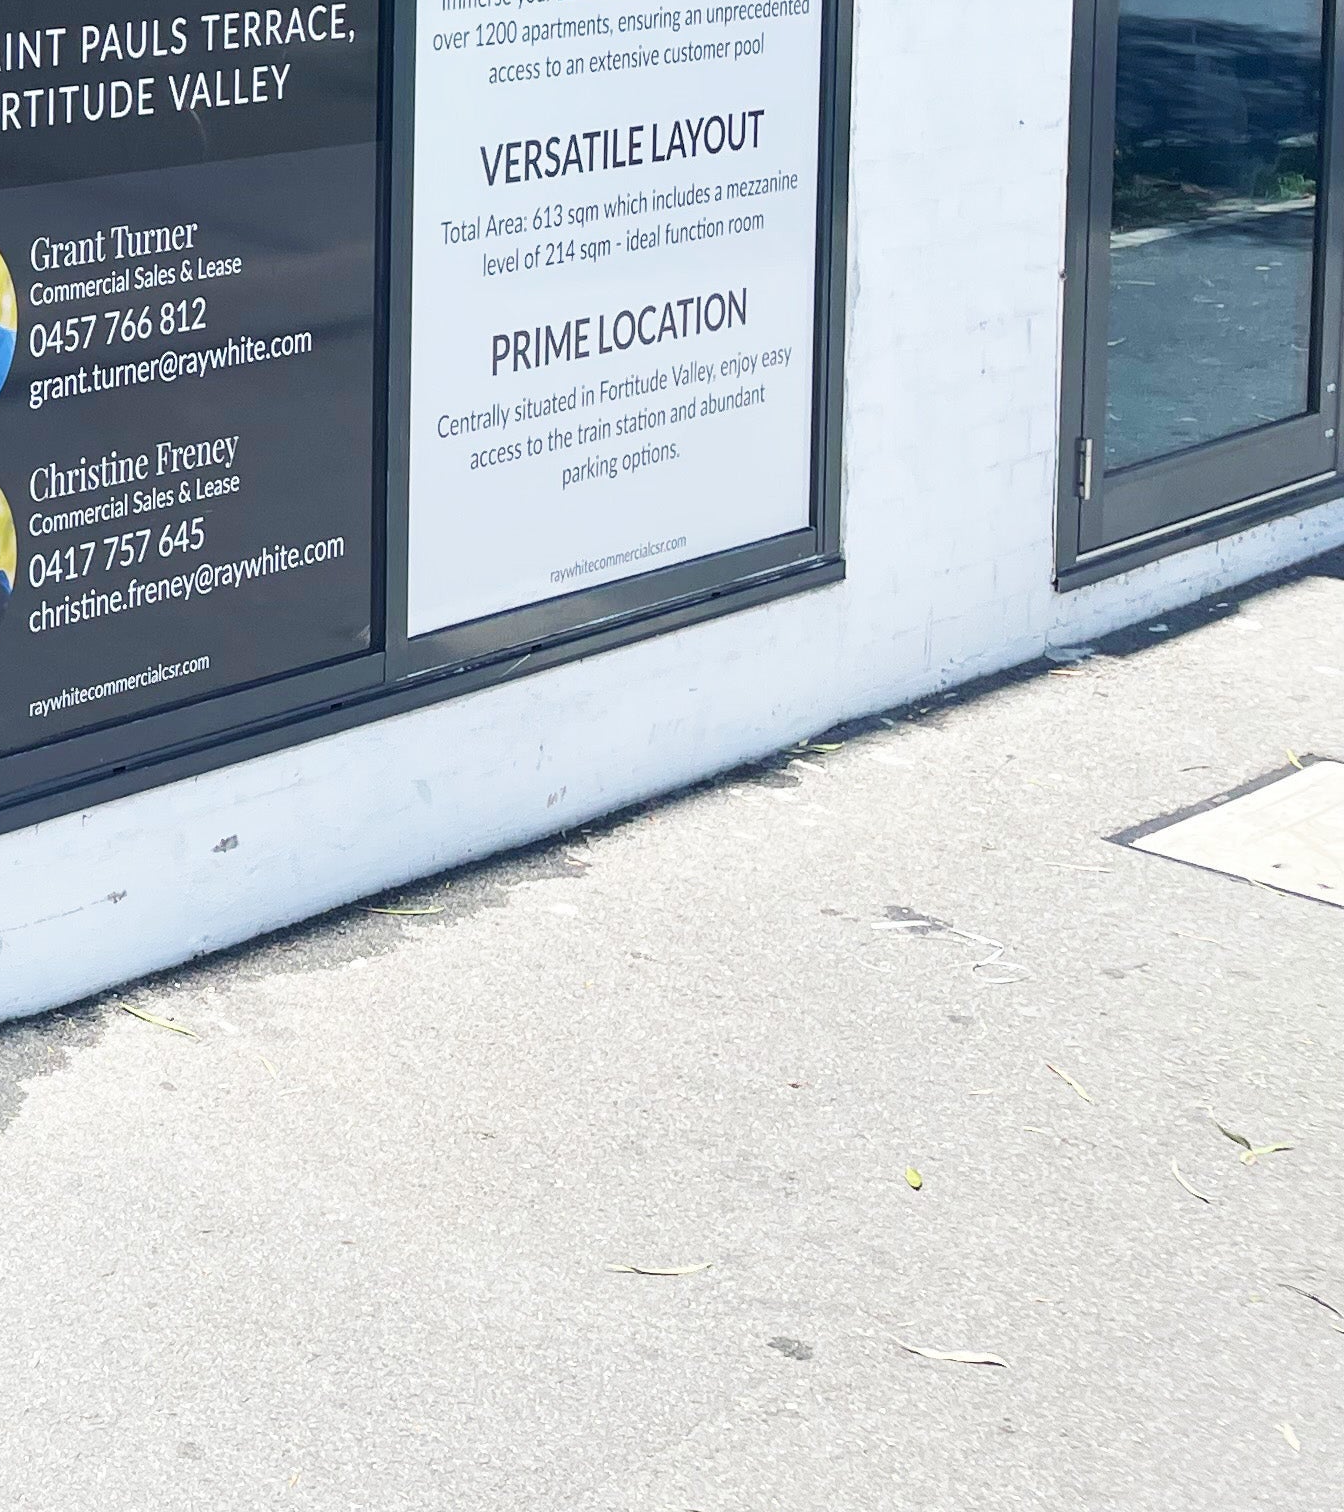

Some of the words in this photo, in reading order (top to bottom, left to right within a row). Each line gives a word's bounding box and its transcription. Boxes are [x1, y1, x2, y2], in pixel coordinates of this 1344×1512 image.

[82, 17, 187, 64] PAULS
[200, 3, 355, 51] TERRACE,
[432, 30, 471, 51] over
[475, 20, 518, 47] 1200
[521, 14, 614, 46] apartments,
[618, 6, 681, 33] ensuring
[684, 8, 702, 26] an
[488, 62, 541, 85] access
[545, 56, 562, 78] to
[566, 57, 584, 76] an
[589, 44, 660, 73] extensive
[663, 41, 731, 65] customer
[734, 31, 765, 62] pool
[168, 63, 291, 111] VALLEY
[479, 124, 644, 187] VERSATILE
[651, 109, 765, 163] LAYOUT
[440, 215, 481, 245] Total
[485, 214, 528, 238] Area:
[532, 203, 563, 231] 613
[567, 204, 599, 228] sqm
[603, 190, 648, 219] which
[652, 182, 711, 213] includes
[714, 185, 722, 202] a
[726, 169, 798, 200] mezzanine
[30, 230, 107, 272] Grant
[110, 223, 198, 260] Turner
[482, 247, 519, 277] level
[524, 244, 541, 270] of
[545, 239, 576, 266] 214
[580, 239, 611, 263] sqm
[626, 224, 661, 252] ideal
[665, 216, 724, 245] function
[728, 213, 764, 235] room
[29, 268, 130, 306] Commercial
[133, 263, 176, 290] Sales
[179, 259, 194, 283] &
[197, 257, 243, 280] Lease
[29, 314, 97, 358] 0457
[104, 305, 153, 345] 766
[159, 296, 207, 335] 812
[492, 317, 591, 377] PRIME
[598, 287, 747, 355] LOCATION
[29, 327, 312, 410] grant.turner@raywhite.com
[437, 403, 511, 439] Centrally
[514, 386, 577, 423] situated
[581, 384, 595, 408] in
[600, 368, 668, 406] Fortitude
[671, 360, 716, 387] Valley,
[720, 351, 759, 379] enjoy
[761, 347, 792, 368] easy
[470, 442, 522, 470] access
[526, 435, 543, 457] to
[547, 427, 573, 452] the
[577, 418, 611, 445] train
[615, 407, 666, 438] station
[670, 396, 696, 424] and
[700, 384, 766, 417] abundant
[29, 450, 150, 503] Christine
[155, 435, 240, 476] Freney
[562, 454, 618, 491] parking
[622, 442, 680, 474] options.
[29, 493, 129, 537] Commercial
[132, 487, 175, 514] Sales
[178, 480, 192, 504] &
[196, 475, 240, 500] Lease
[29, 541, 96, 589] 0417
[103, 528, 152, 571] 757
[158, 516, 205, 558] 645
[29, 534, 345, 633] christine.freney@raywhite.com
[550, 536, 687, 582] raywhitecommercialcsr.com
[29, 655, 210, 718] raywhitecommercialcsr.com
